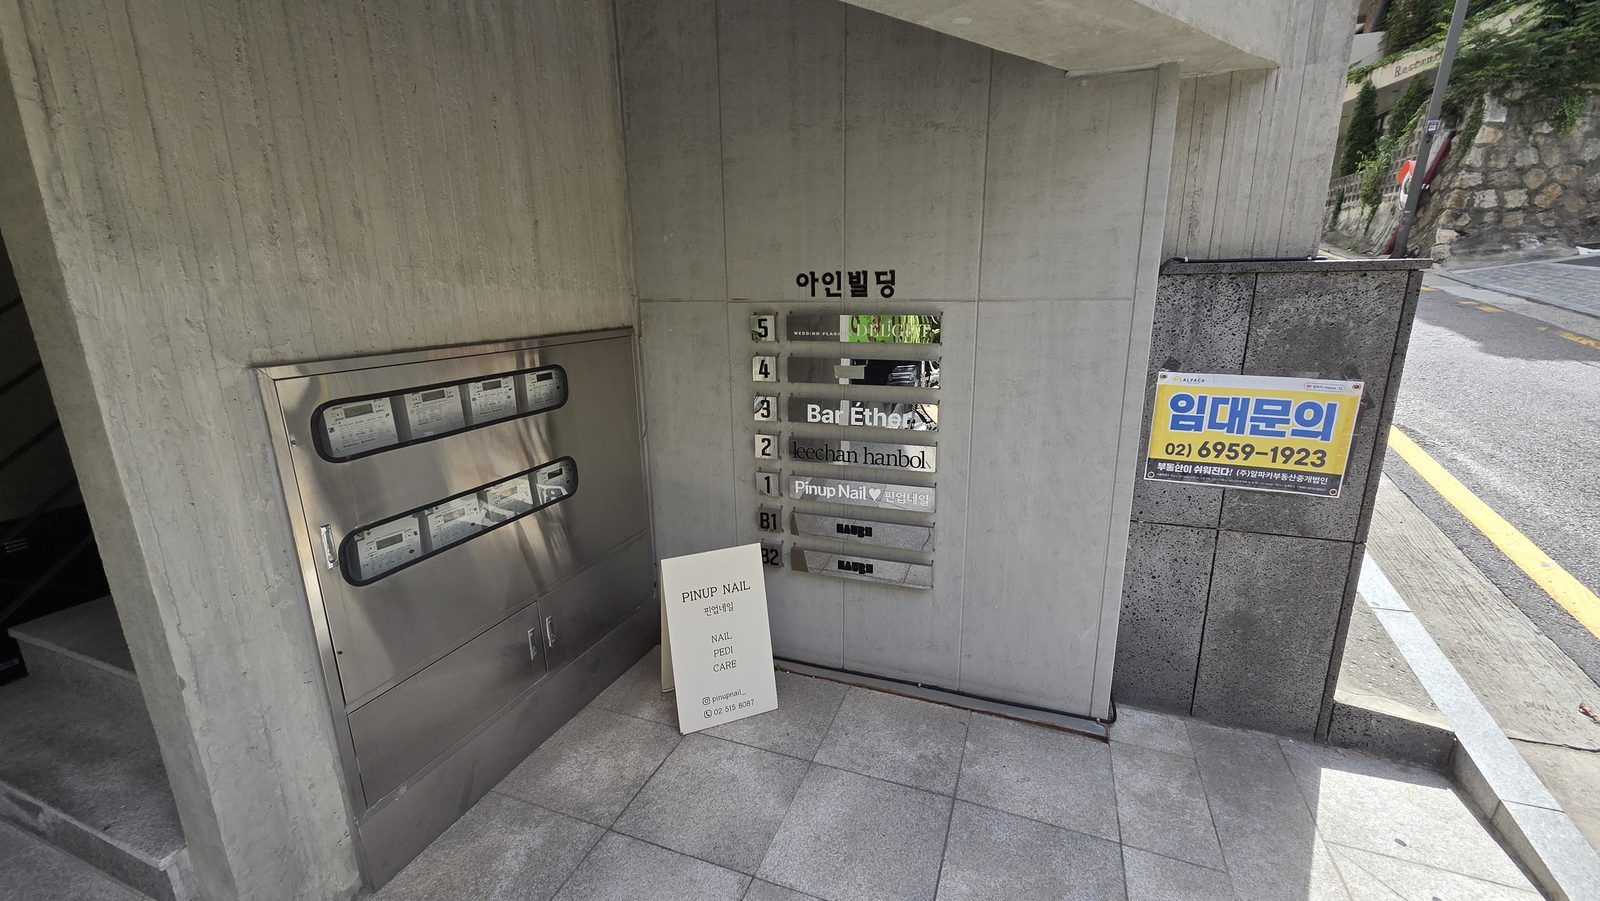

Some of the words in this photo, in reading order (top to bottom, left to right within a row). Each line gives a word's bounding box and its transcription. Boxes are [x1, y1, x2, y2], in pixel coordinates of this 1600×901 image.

[796, 269, 896, 298] 아인빌딩
[757, 318, 768, 338] 5
[758, 359, 770, 379] 4
[760, 399, 770, 419] 3
[807, 404, 844, 424] Bar
[850, 401, 913, 429] Éther
[1169, 392, 1338, 442] 임대문의
[761, 438, 771, 457] 2
[792, 441, 858, 464] leechan
[1165, 443, 1192, 458] 02)
[1197, 441, 1327, 468] 6959-1923
[1194, 466, 1233, 477] 쉬워진다!
[764, 476, 771, 494] 1
[794, 480, 836, 499] Pinup
[838, 484, 867, 500] Nail
[884, 490, 929, 507] 핀업네일
[760, 512, 777, 531] B1
[761, 547, 779, 566] B2
[682, 586, 718, 603] PINUP
[723, 580, 751, 594] NAIL
[704, 602, 734, 616] 핀업네일
[711, 631, 733, 644] NAIL
[713, 645, 734, 658] PEDI
[712, 659, 737, 673] CARE
[713, 707, 723, 715] 02
[724, 703, 736, 713] 515
[738, 698, 754, 709] 8087
